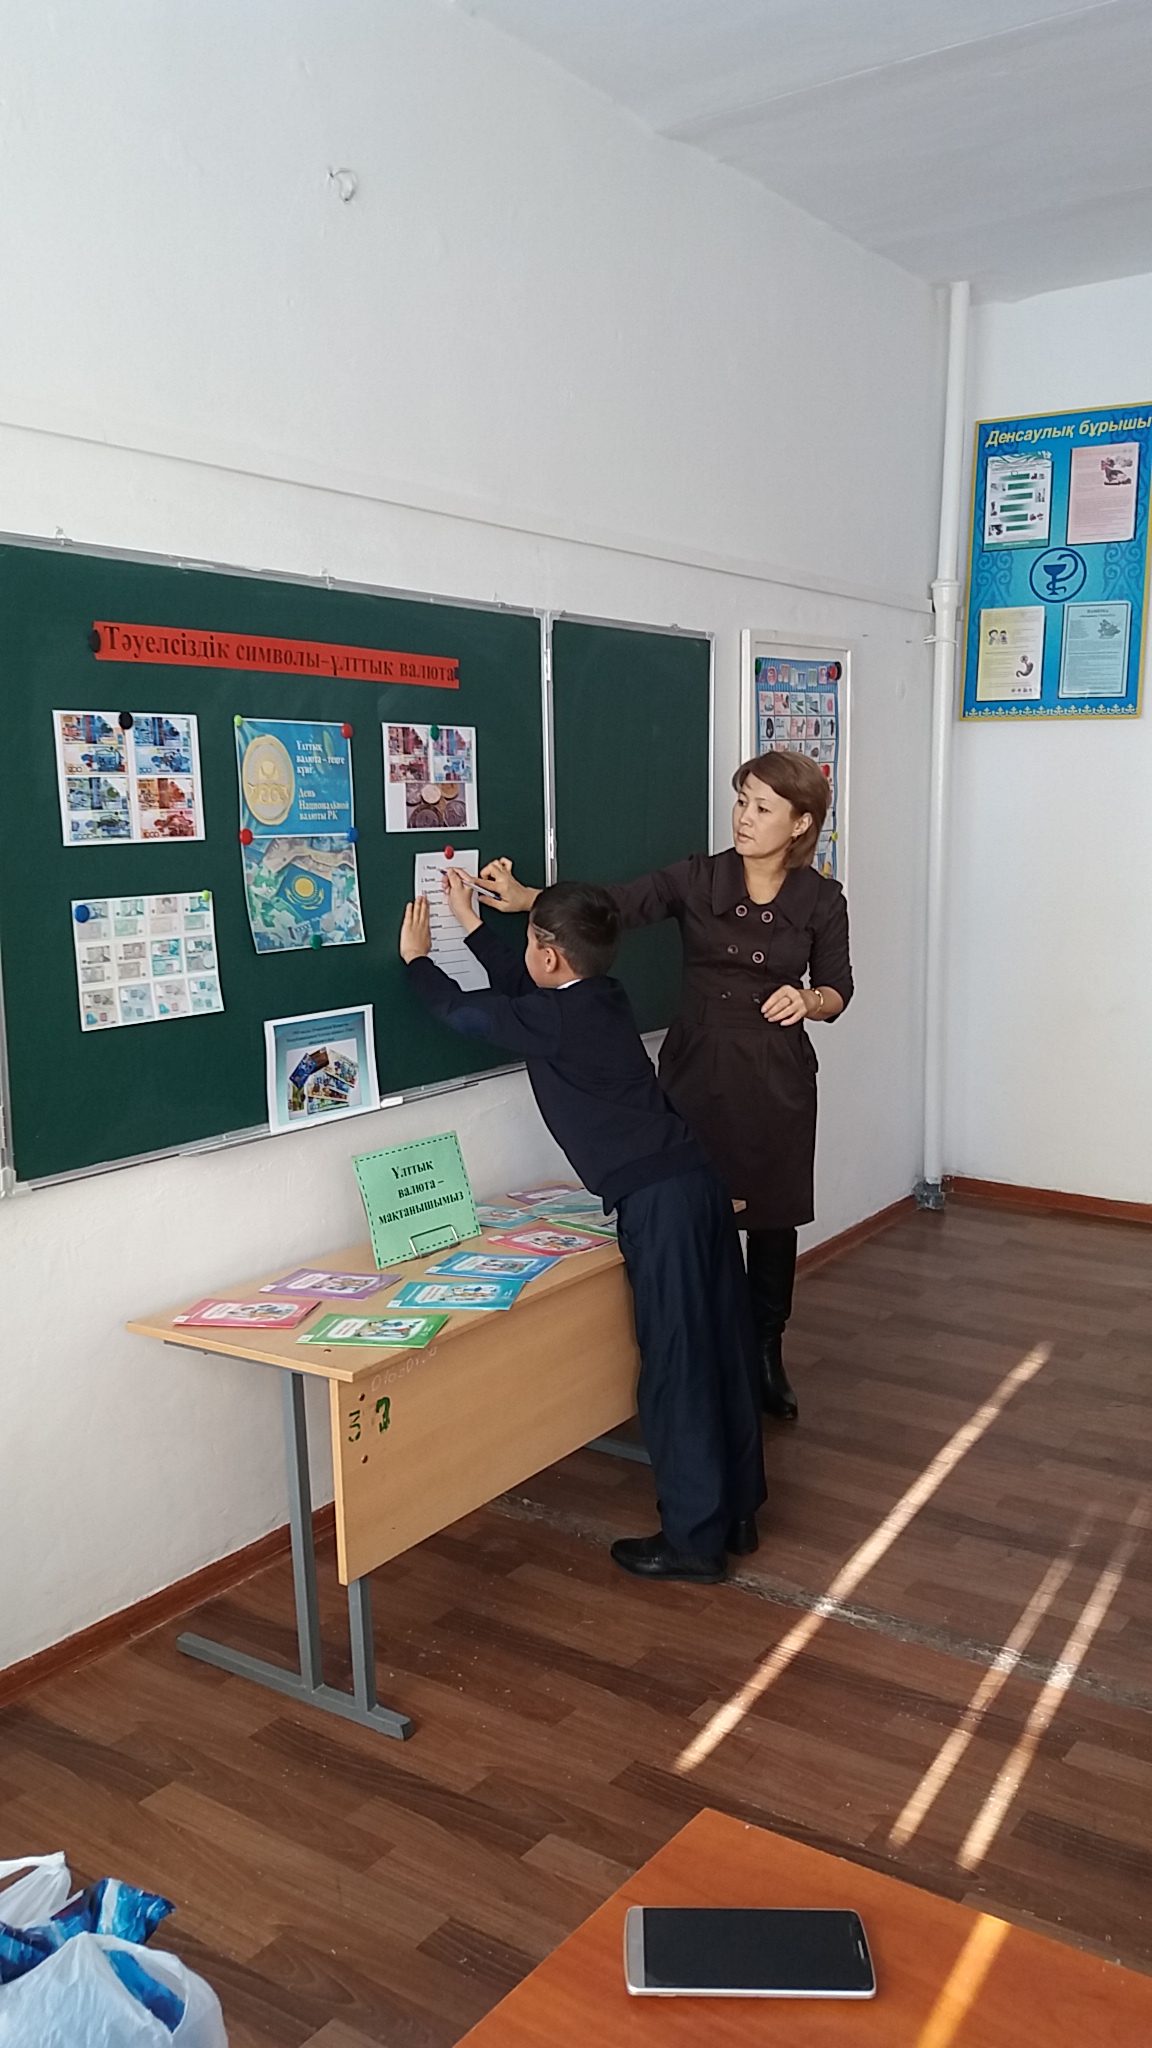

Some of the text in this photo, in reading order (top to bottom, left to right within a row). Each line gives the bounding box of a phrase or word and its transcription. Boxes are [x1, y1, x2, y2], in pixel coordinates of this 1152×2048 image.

[985, 416, 1152, 448] Денсаулық бұрышы
[104, 625, 229, 659] Тәуелсіздік
[400, 662, 455, 682] валюта
[398, 1180, 437, 1199] валюта
